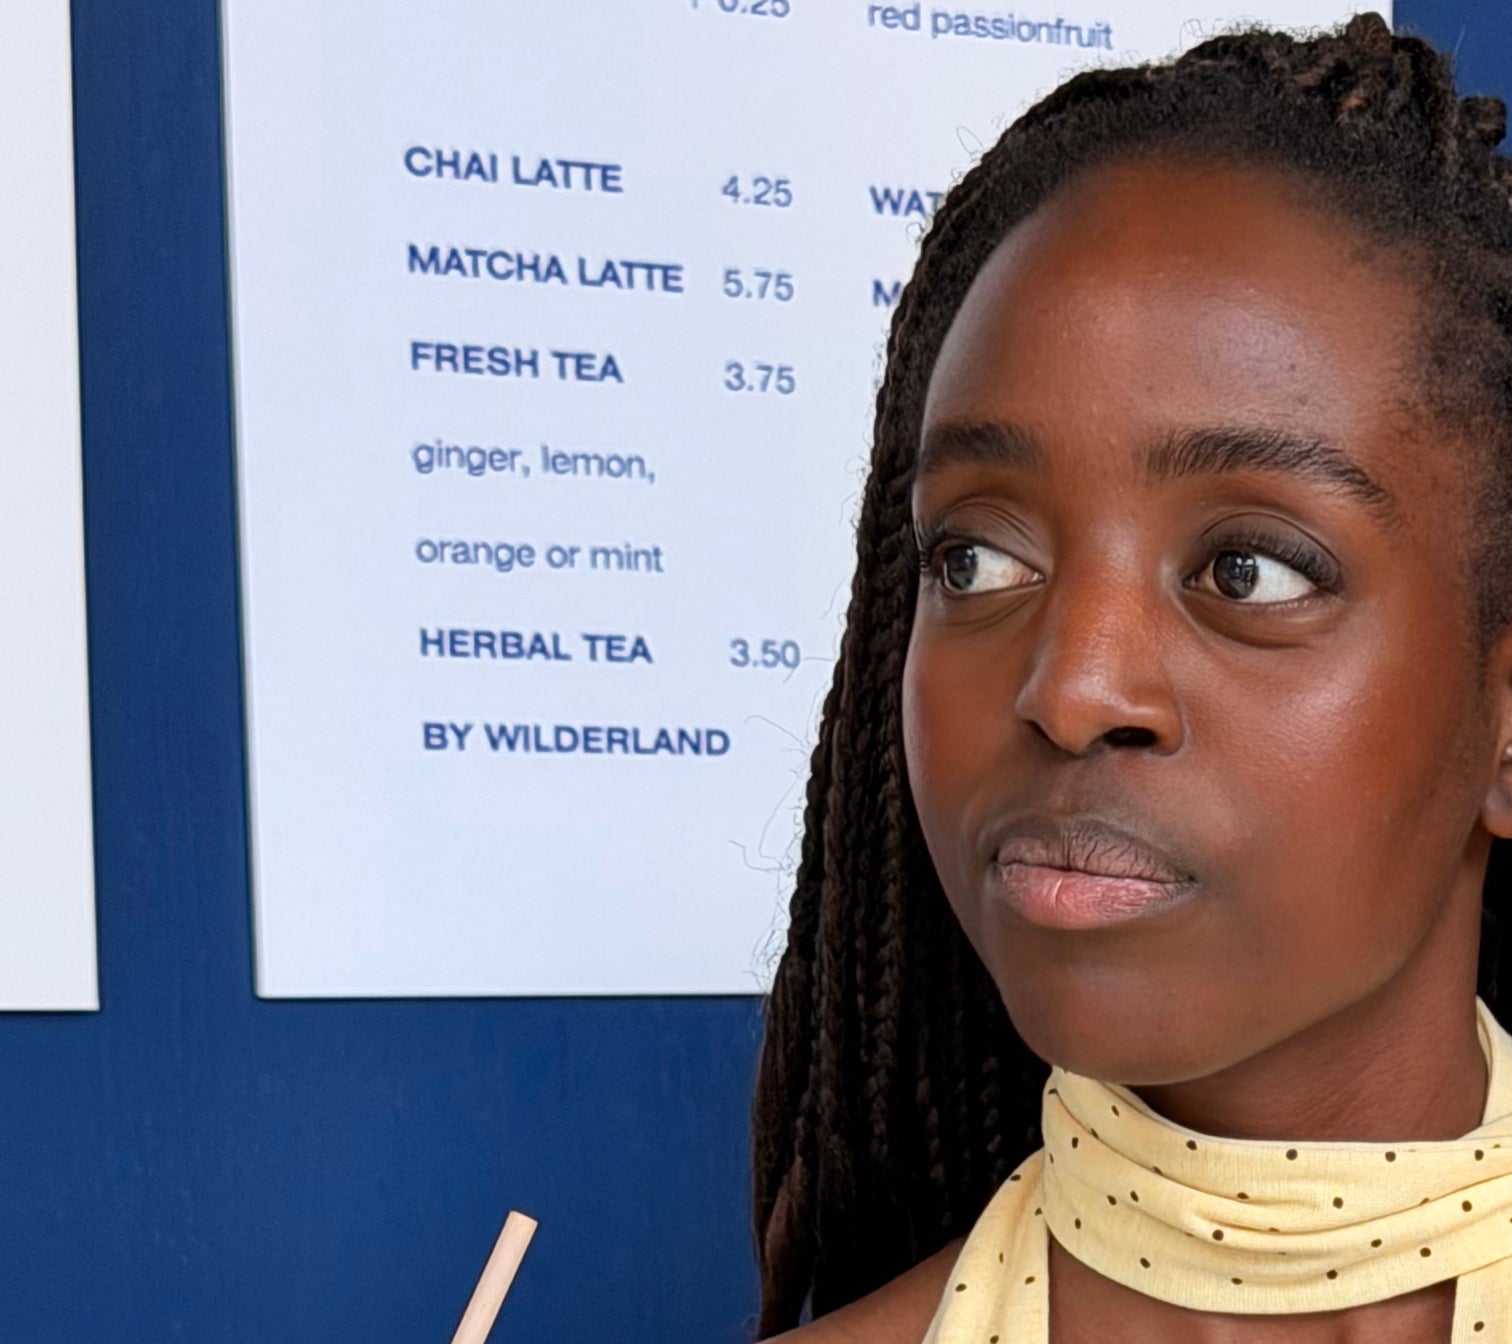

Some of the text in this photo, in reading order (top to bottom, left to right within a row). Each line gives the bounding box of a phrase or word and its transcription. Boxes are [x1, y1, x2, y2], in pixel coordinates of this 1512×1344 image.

[866, 3, 1114, 51] red passionfruit
[403, 145, 793, 208] CHAI LATTE 4.25
[407, 243, 795, 302] MATCHA LATTE 5.75
[410, 340, 796, 395] FRESH TEA 3.75
[412, 439, 656, 484] ginger, lemon,
[414, 536, 664, 573] orange or mint
[419, 627, 801, 670] HERBAL TEA 3.50
[422, 721, 732, 757] BY WILDERLAND
